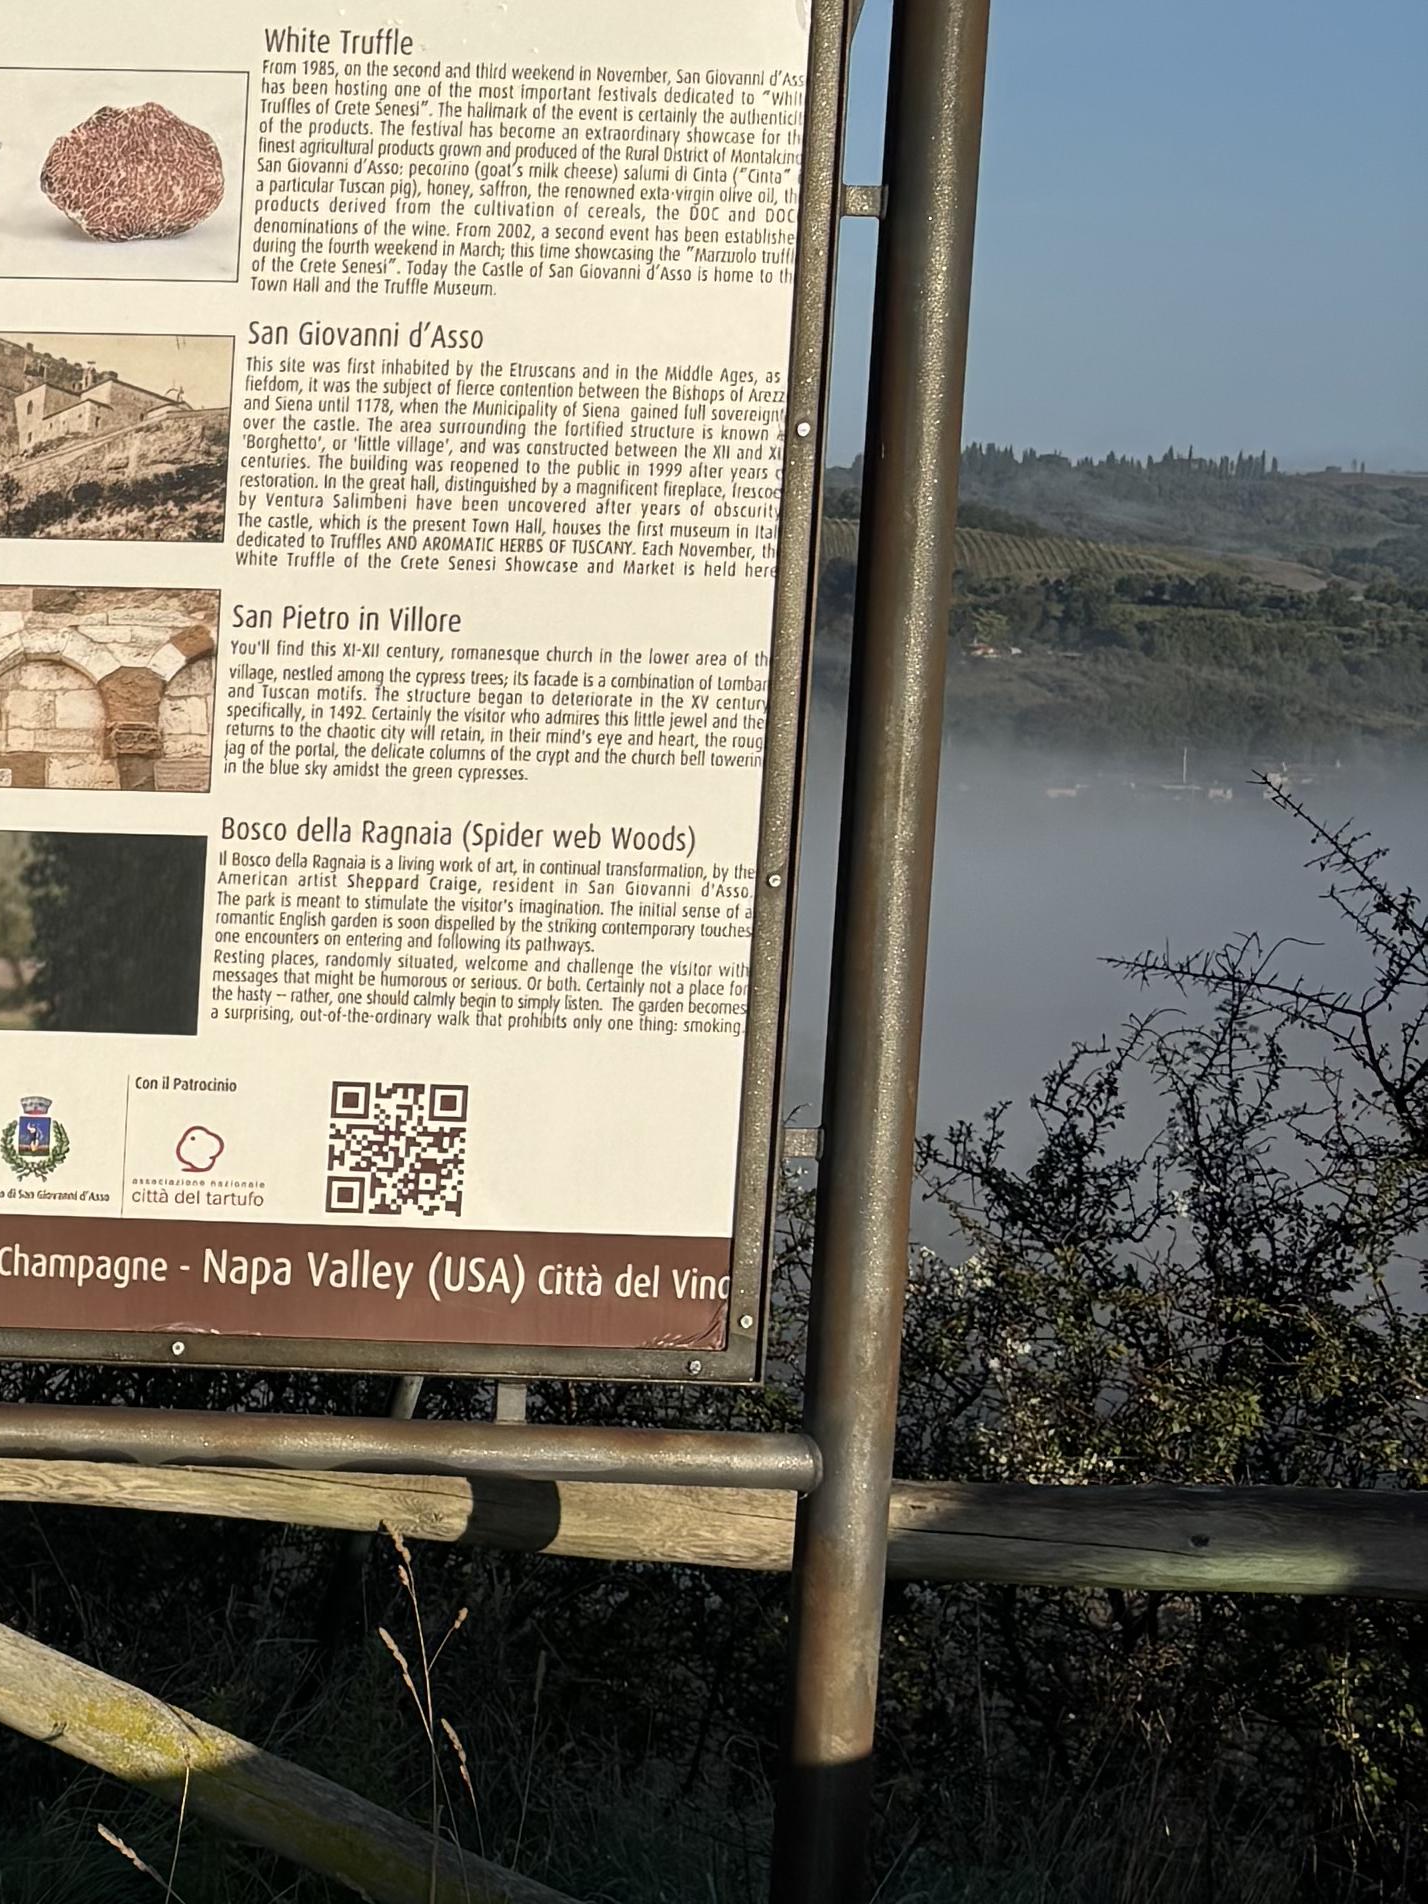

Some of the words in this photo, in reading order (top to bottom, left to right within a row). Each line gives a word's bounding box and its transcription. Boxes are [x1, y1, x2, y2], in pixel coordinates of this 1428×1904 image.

[264, 25, 330, 53] White
[340, 27, 413, 55] Truffle
[251, 276, 287, 291] Town
[293, 277, 319, 292] Hall
[324, 277, 350, 293] and
[356, 277, 378, 293] the
[384, 278, 428, 294] Truffle
[248, 320, 287, 345] San
[299, 320, 399, 347] Giovanni
[409, 321, 483, 349] d'Asso
[238, 493, 256, 510] by
[266, 492, 323, 508] Ventura
[333, 493, 407, 510] Salimbeni
[416, 495, 452, 510] have
[461, 495, 498, 511] been
[508, 497, 586, 513] uncovered
[596, 497, 631, 514] after
[641, 503, 680, 519] years
[690, 500, 704, 516] of
[232, 604, 272, 628] San
[283, 604, 349, 630] Pietro
[359, 605, 378, 630] in
[389, 605, 461, 632] Villore
[224, 758, 236, 774] in
[242, 758, 264, 774] the
[269, 759, 299, 775] blue
[304, 759, 327, 778] sky
[332, 760, 379, 777] amidst
[385, 762, 407, 777] the
[412, 766, 452, 781] green
[221, 816, 286, 841] Bosco
[297, 816, 351, 842] della
[362, 820, 451, 850] Ragnaia
[462, 820, 543, 853] (Spider
[553, 823, 601, 849] web
[611, 825, 695, 858] Woods)
[215, 931, 240, 943] one
[245, 931, 319, 945] encounters
[324, 934, 340, 945] on
[346, 932, 402, 951] entering
[407, 933, 432, 948] and
[437, 933, 500, 953] following
[505, 935, 520, 950] its
[135, 1076, 158, 1089] Con
[162, 1075, 169, 1089] il
[173, 1077, 237, 1092] Patrocinio
[131, 1188, 168, 1203] città
[174, 1189, 199, 1204] del
[206, 1191, 264, 1206] tartufo
[203, 1248, 291, 1294] Napa
[307, 1248, 413, 1299] Valley
[428, 1251, 525, 1304] (USA)
[538, 1263, 602, 1296] Città
[615, 1263, 659, 1297] del
